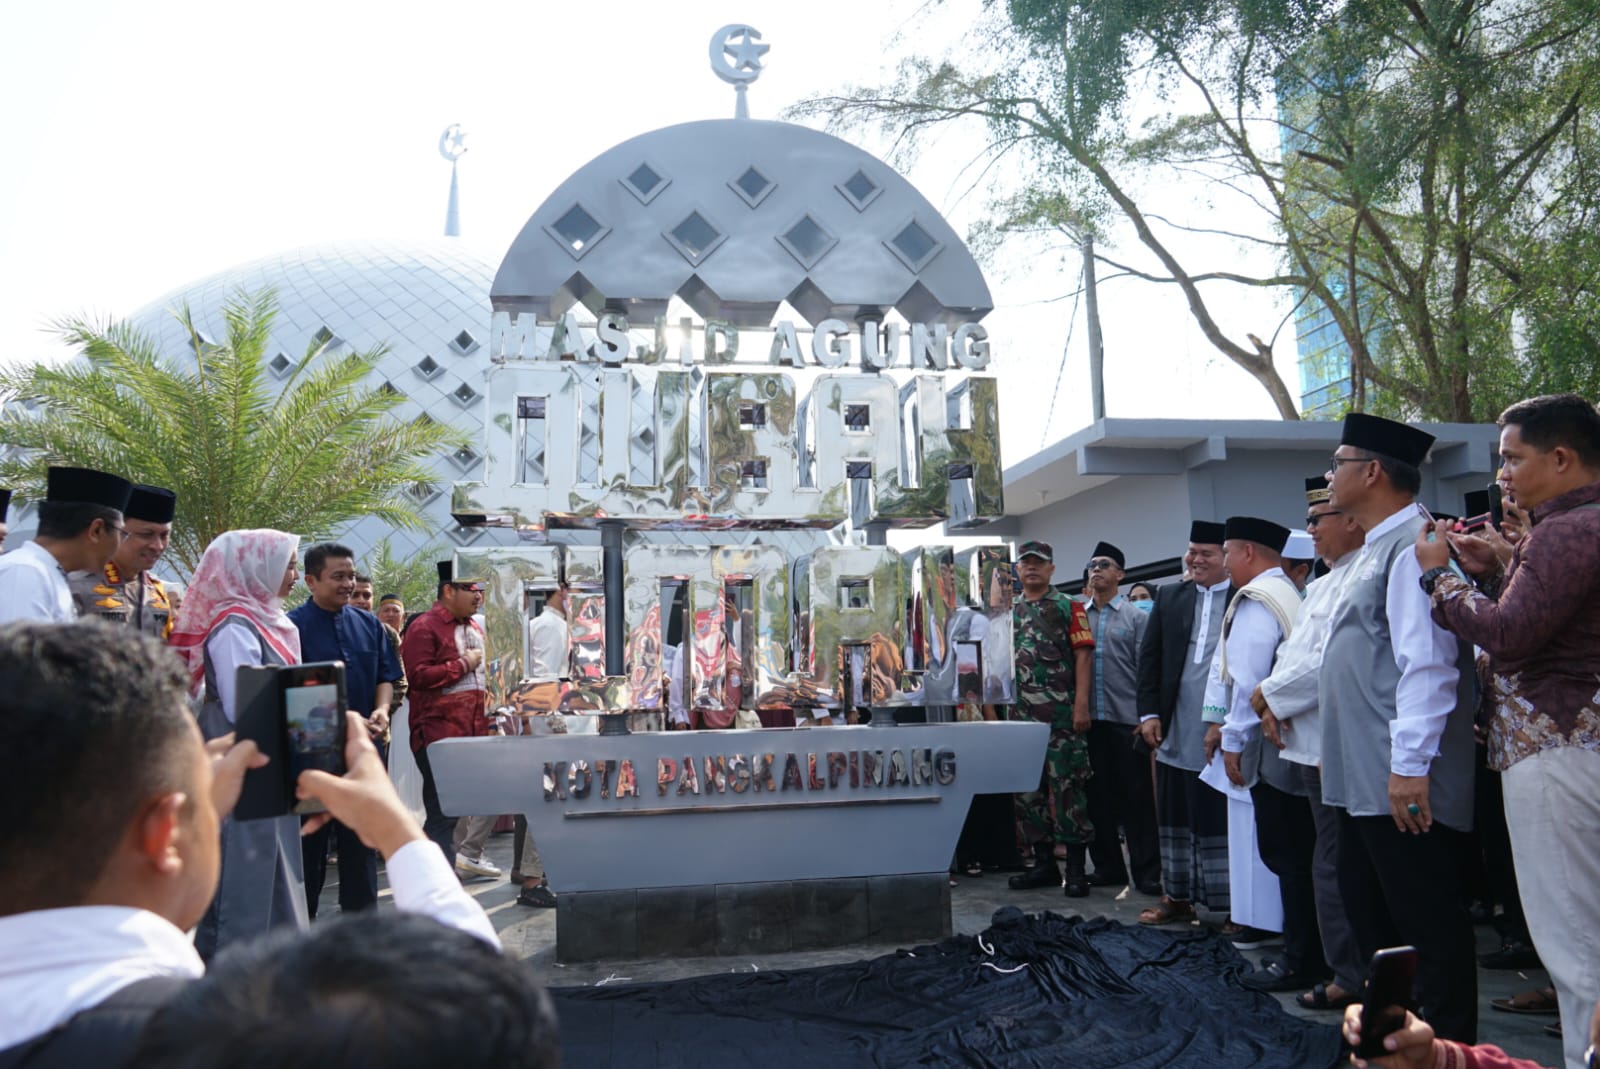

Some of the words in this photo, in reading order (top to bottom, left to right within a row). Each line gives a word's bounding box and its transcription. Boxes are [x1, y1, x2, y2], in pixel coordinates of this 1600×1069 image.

[490, 311, 740, 366] MASJID
[768, 318, 992, 371] AGUNG
[453, 545, 1017, 715] TIMAH
[543, 759, 640, 801] KOTA
[657, 748, 957, 799] PANGKALPINANG
